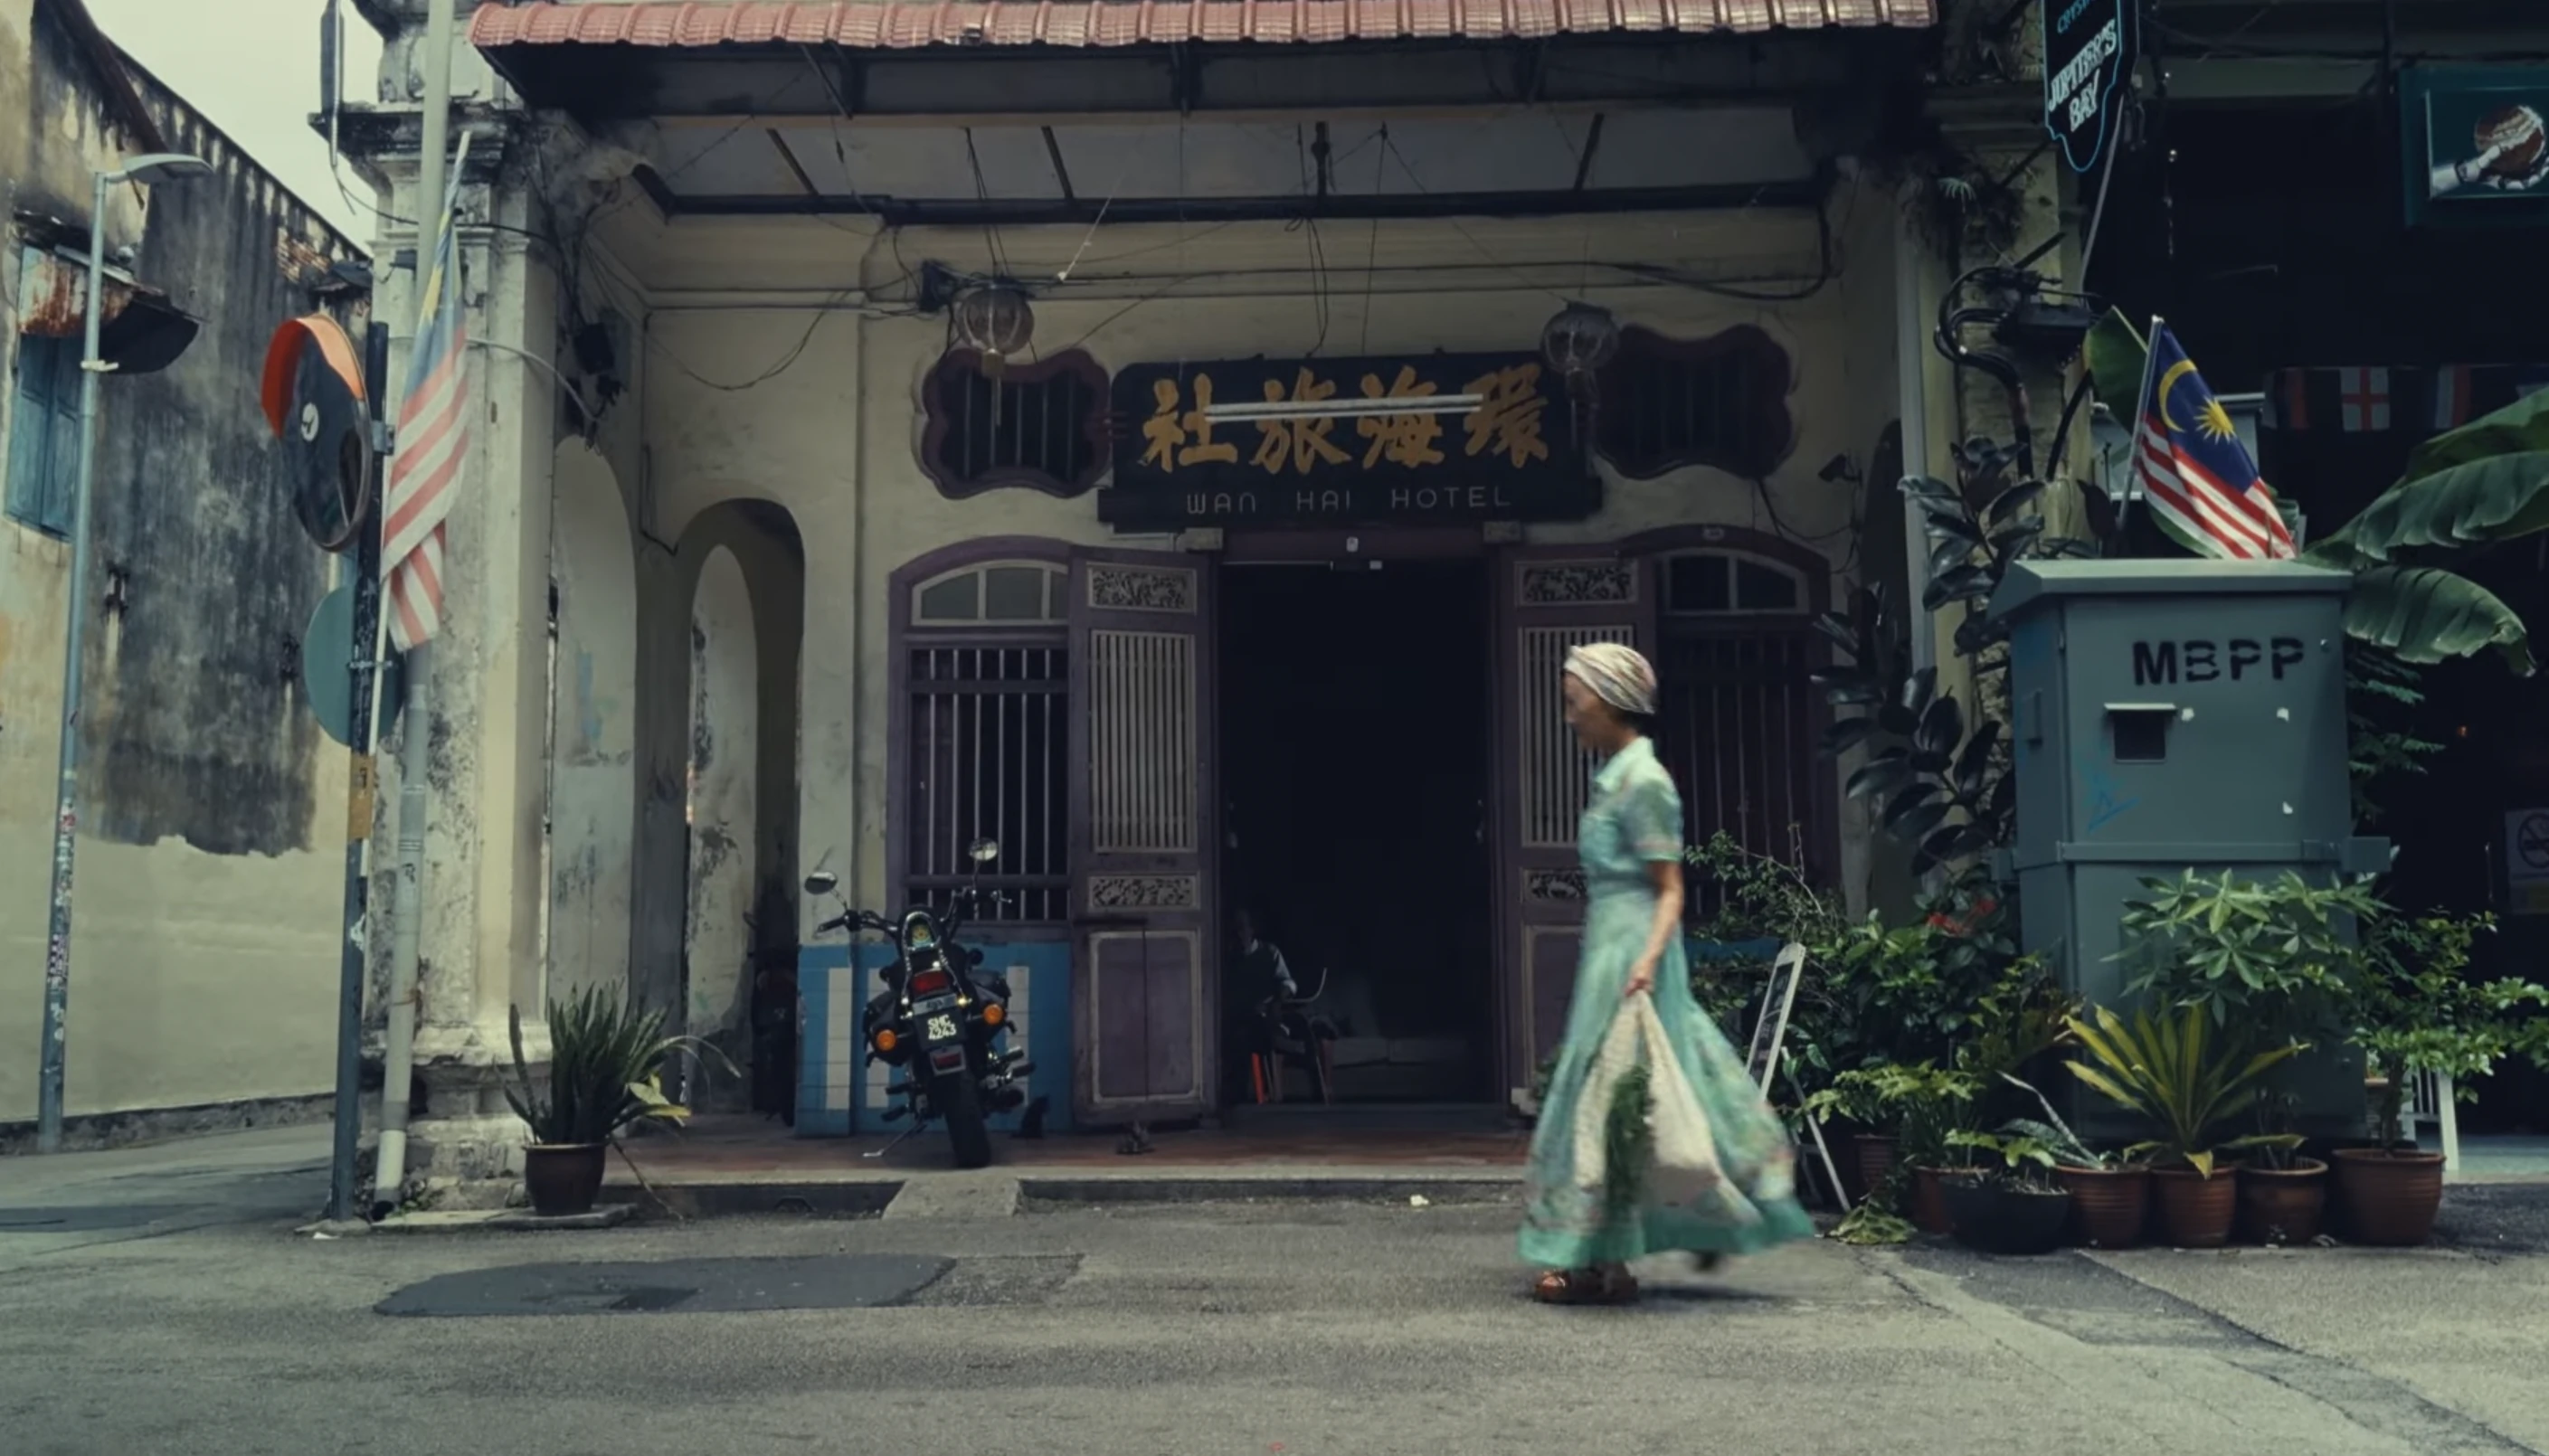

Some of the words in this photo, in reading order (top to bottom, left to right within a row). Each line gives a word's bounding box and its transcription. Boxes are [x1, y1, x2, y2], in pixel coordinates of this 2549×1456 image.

[2069, 68, 2100, 132] BAY
[1186, 492, 1256, 515] WAN
[1296, 489, 1351, 513] HAI
[1391, 485, 1511, 509] HOTEL
[2132, 636, 2306, 685] MBPP
